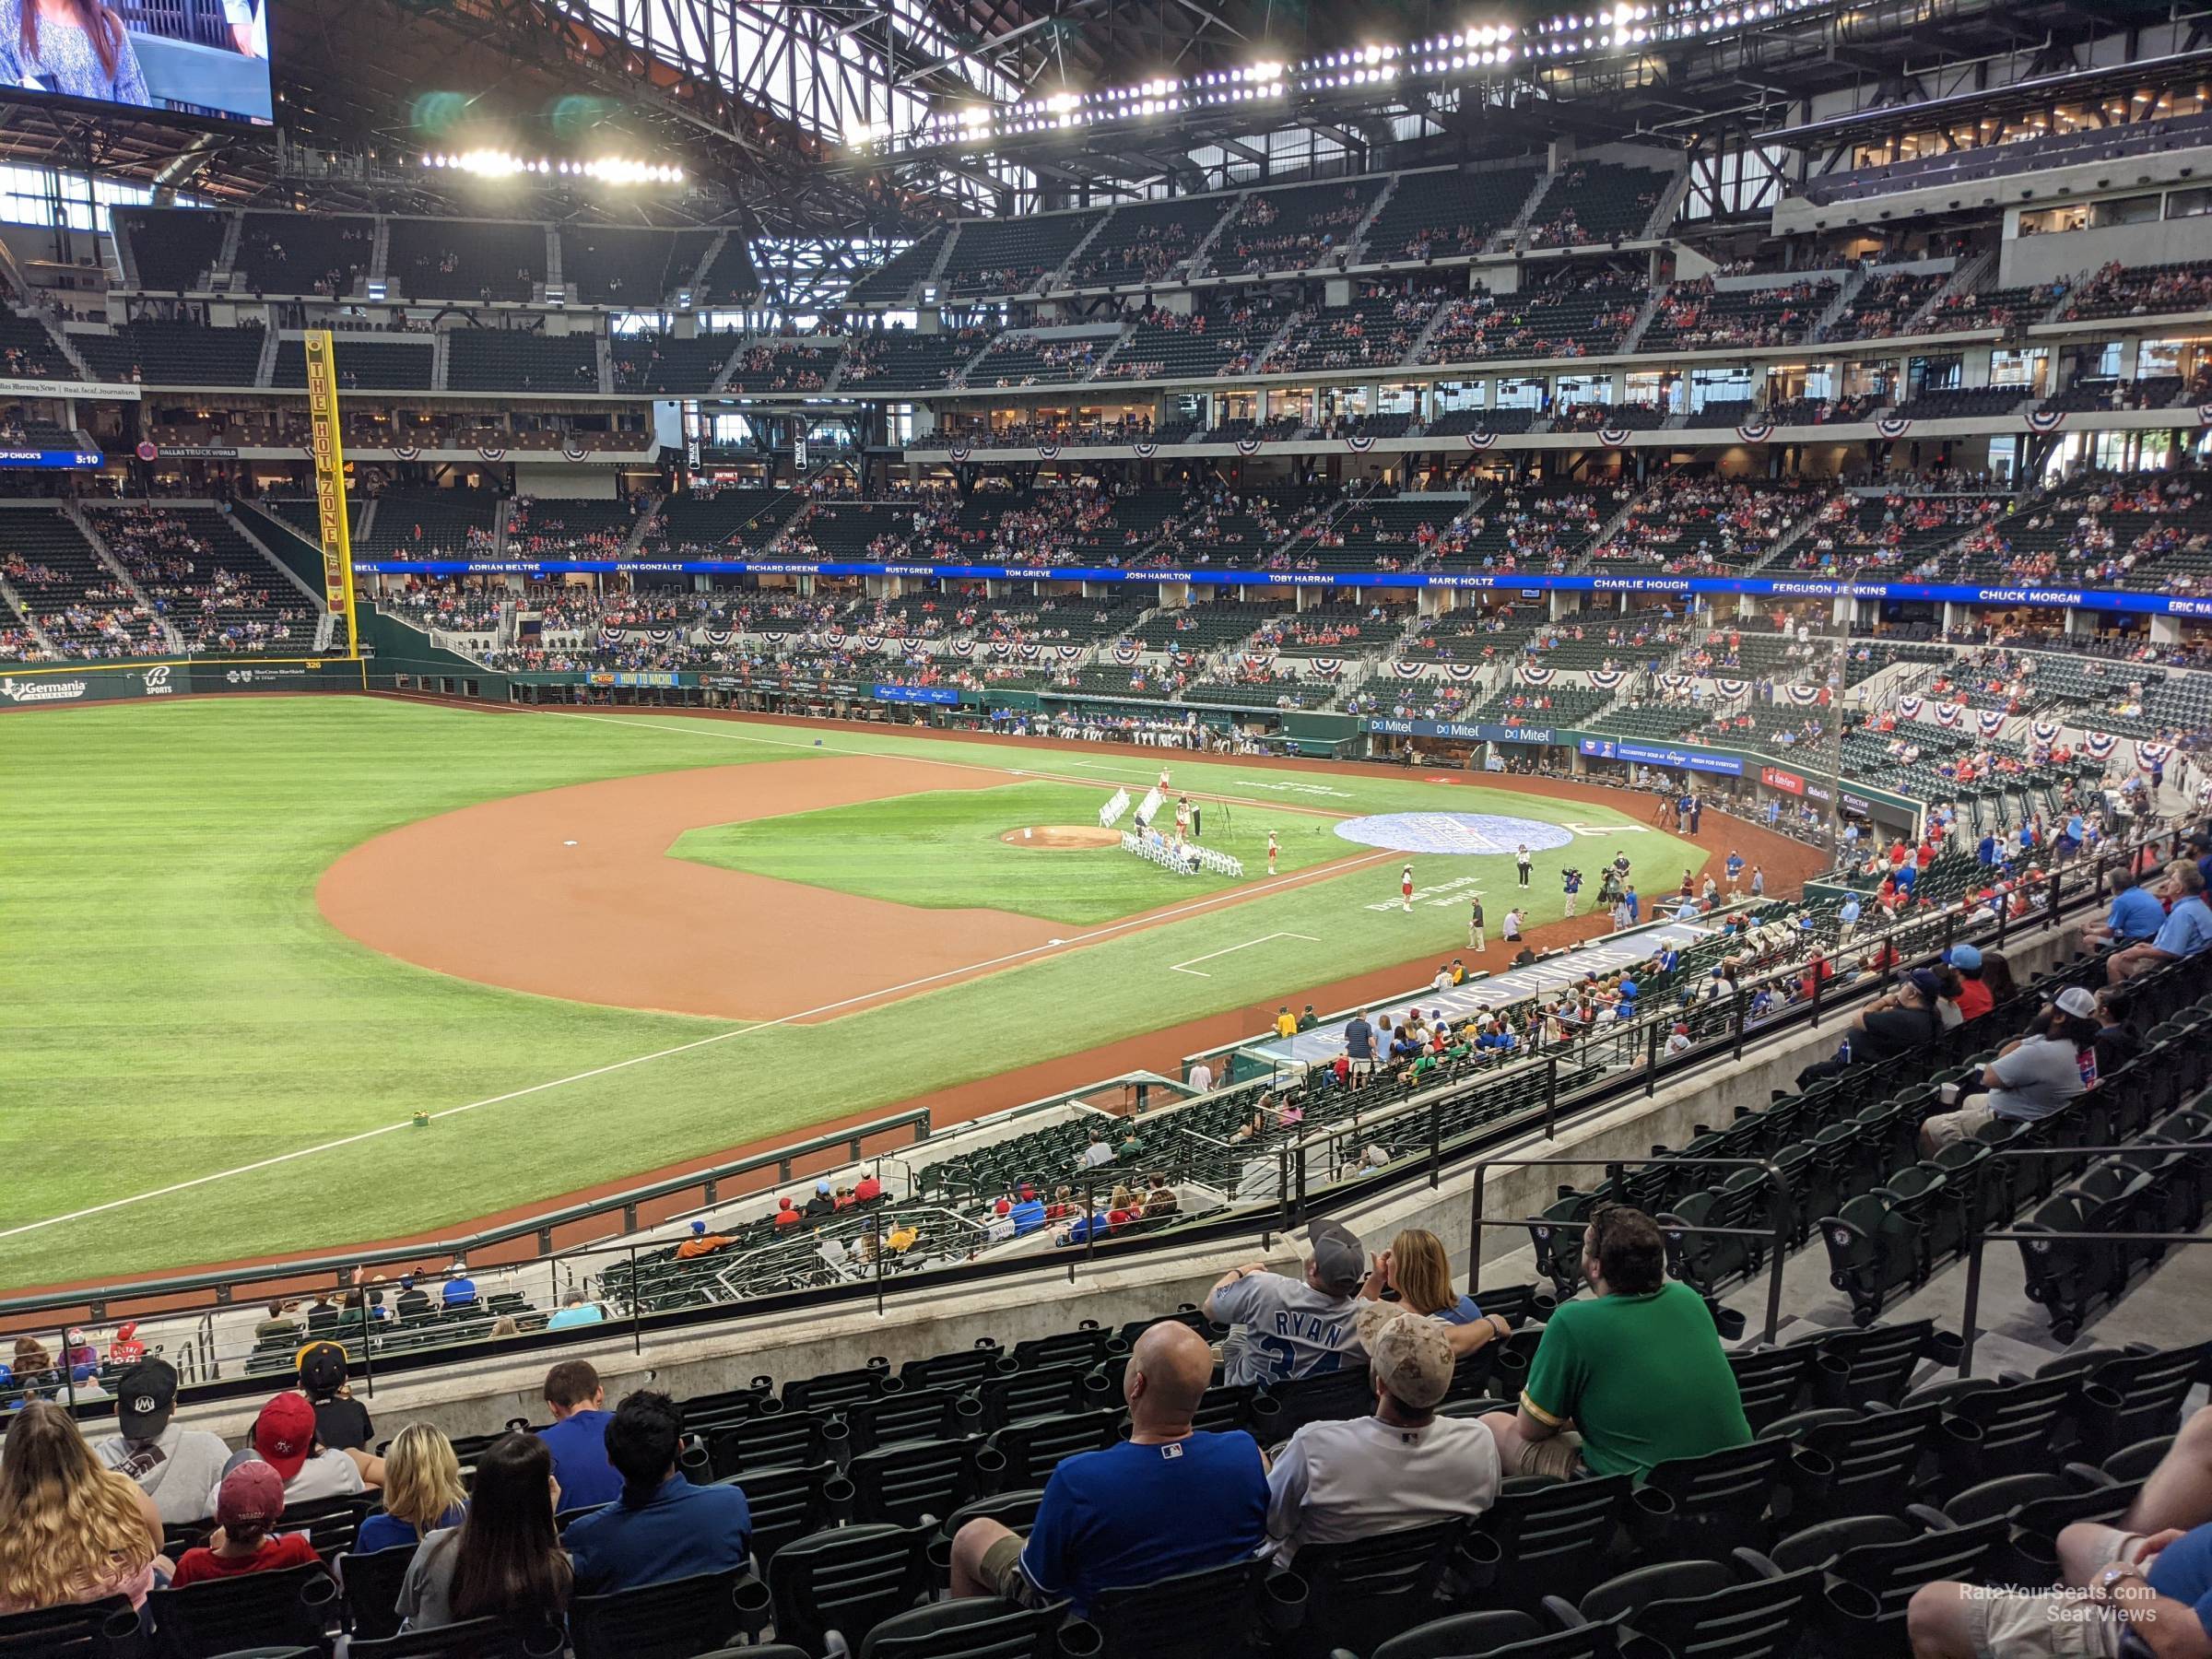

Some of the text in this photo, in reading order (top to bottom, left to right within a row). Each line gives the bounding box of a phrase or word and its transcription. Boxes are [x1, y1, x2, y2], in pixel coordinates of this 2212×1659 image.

[310, 362, 325, 412] THE
[316, 420, 331, 470] HOT
[76, 455, 99, 465] 5:10
[322, 480, 338, 543] ZONE
[615, 563, 640, 571] JUAN
[885, 567, 908, 575] RUSTY
[1124, 571, 1147, 580] JOSH
[1268, 574, 1334, 583] TOBY HARRAH
[1429, 577, 1494, 586] MARK HOLTZ
[1594, 580, 1688, 590] CHARLIE HOUGH
[1772, 583, 1832, 594] FERGUSON
[1979, 590, 2080, 604] CHUCK MORGAN
[2168, 601, 2194, 612] ERIC
[305, 661, 321, 669] 326
[639, 673, 647, 684] TO
[25, 679, 88, 693] Germania
[147, 686, 172, 695] SPORTS
[1385, 721, 1412, 733] Mitel
[1451, 724, 1479, 736] Mitel
[1520, 729, 1549, 741] Mitel
[1666, 751, 1686, 765] Kroger
[1807, 786, 1829, 800] Globe Life
[1496, 947, 1637, 990] RANGERS
[1275, 1310, 1343, 1348] RYAN
